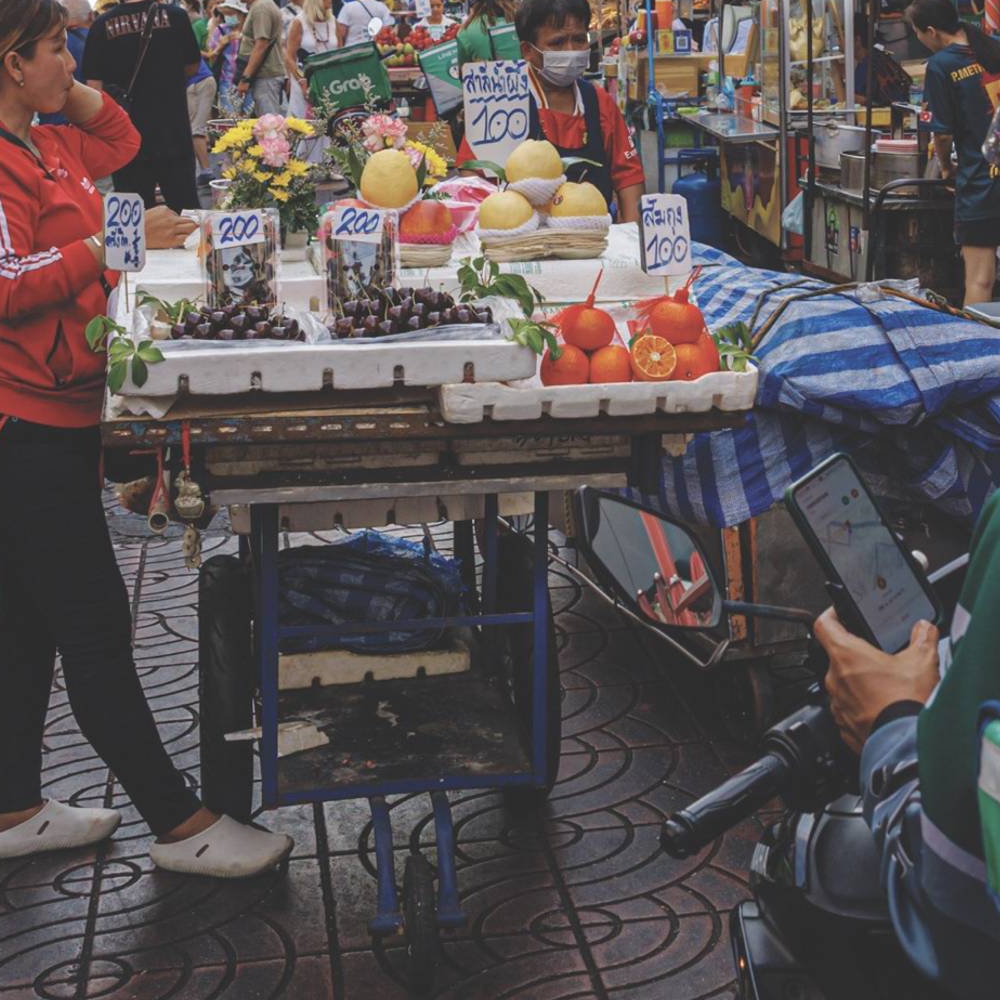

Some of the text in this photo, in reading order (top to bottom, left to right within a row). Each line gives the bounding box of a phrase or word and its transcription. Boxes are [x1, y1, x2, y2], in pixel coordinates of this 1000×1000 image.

[472, 104, 528, 146] 100
[106, 196, 142, 228] 200
[335, 206, 380, 236] 200
[218, 213, 260, 244] 200
[646, 233, 688, 270] 100
